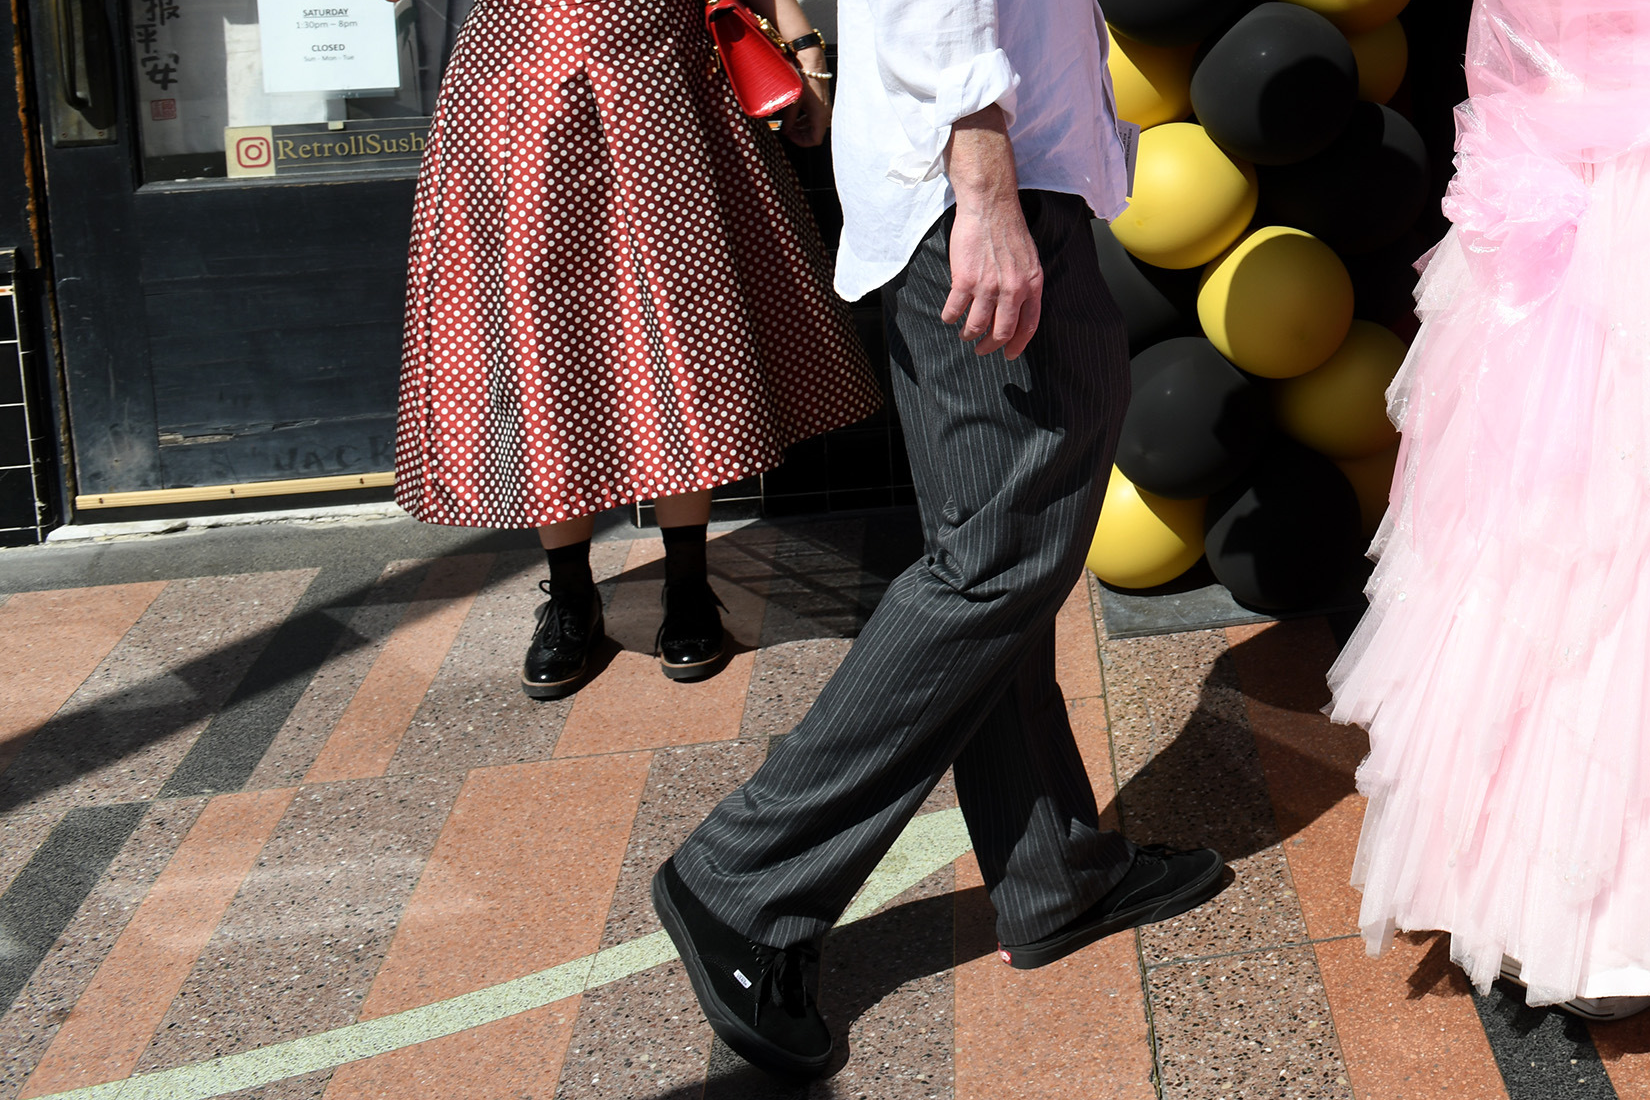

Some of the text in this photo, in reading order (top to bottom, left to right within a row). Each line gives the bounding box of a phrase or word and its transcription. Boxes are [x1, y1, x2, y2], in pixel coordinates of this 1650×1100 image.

[303, 8, 349, 17] SATURDAY
[296, 21, 329, 29] 1:30pm
[338, 20, 358, 28] 8pm
[311, 44, 346, 52] CLOSED
[276, 131, 425, 160] RetrollSush
